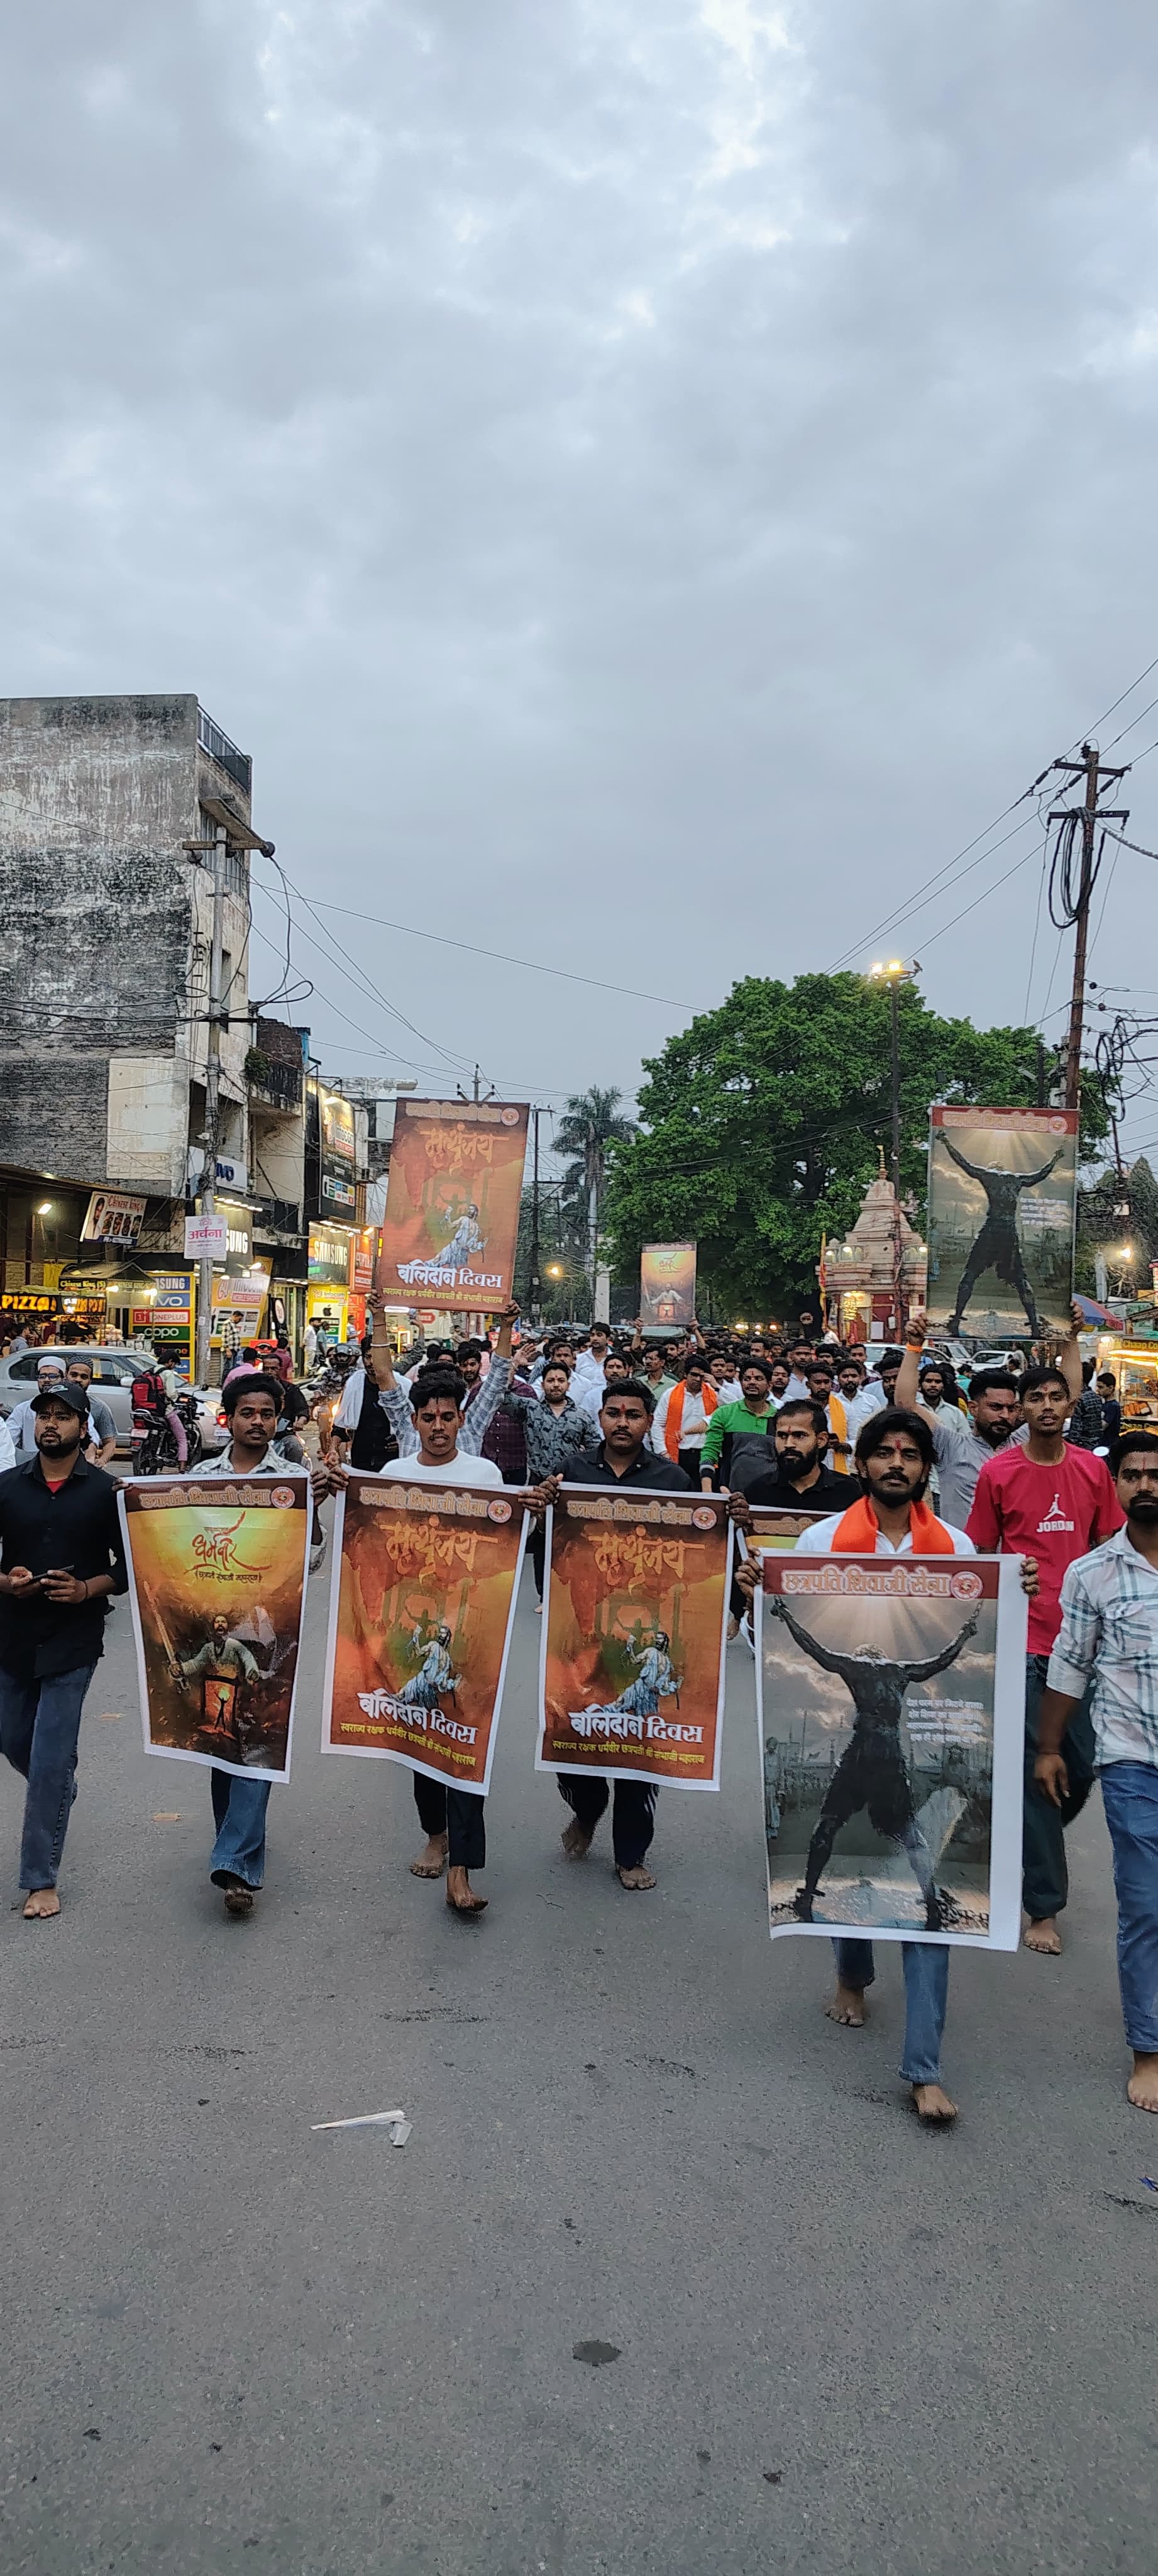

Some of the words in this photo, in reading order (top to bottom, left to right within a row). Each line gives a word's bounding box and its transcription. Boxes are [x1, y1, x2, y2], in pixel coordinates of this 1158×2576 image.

[188, 1227, 223, 1240] अर्चना
[226, 1229, 248, 1254] SUNG
[314, 1240, 347, 1266] SAMSUNG
[158, 1277, 185, 1289] SUNG
[397, 1259, 456, 1288] बलिदान
[458, 1268, 503, 1288] दिवस
[1123, 1340, 1147, 1348] Chaap
[783, 1563, 844, 1594] छत्रपति
[844, 1563, 909, 1596] शिवाजी
[910, 1565, 952, 1596] सेना
[357, 1687, 427, 1730] बलिदान
[429, 1709, 478, 1745] दिवस
[568, 1703, 646, 1740] बलिदान
[646, 1716, 705, 1743] दिवस
[340, 1723, 365, 1733] स्वराज्य
[367, 1725, 385, 1735] रक्षक
[386, 1724, 407, 1739] धर्मवीर
[552, 1740, 577, 1750] स्वराज्य
[578, 1742, 597, 1752] रक्षक
[598, 1741, 620, 1753] धर्मवीर
